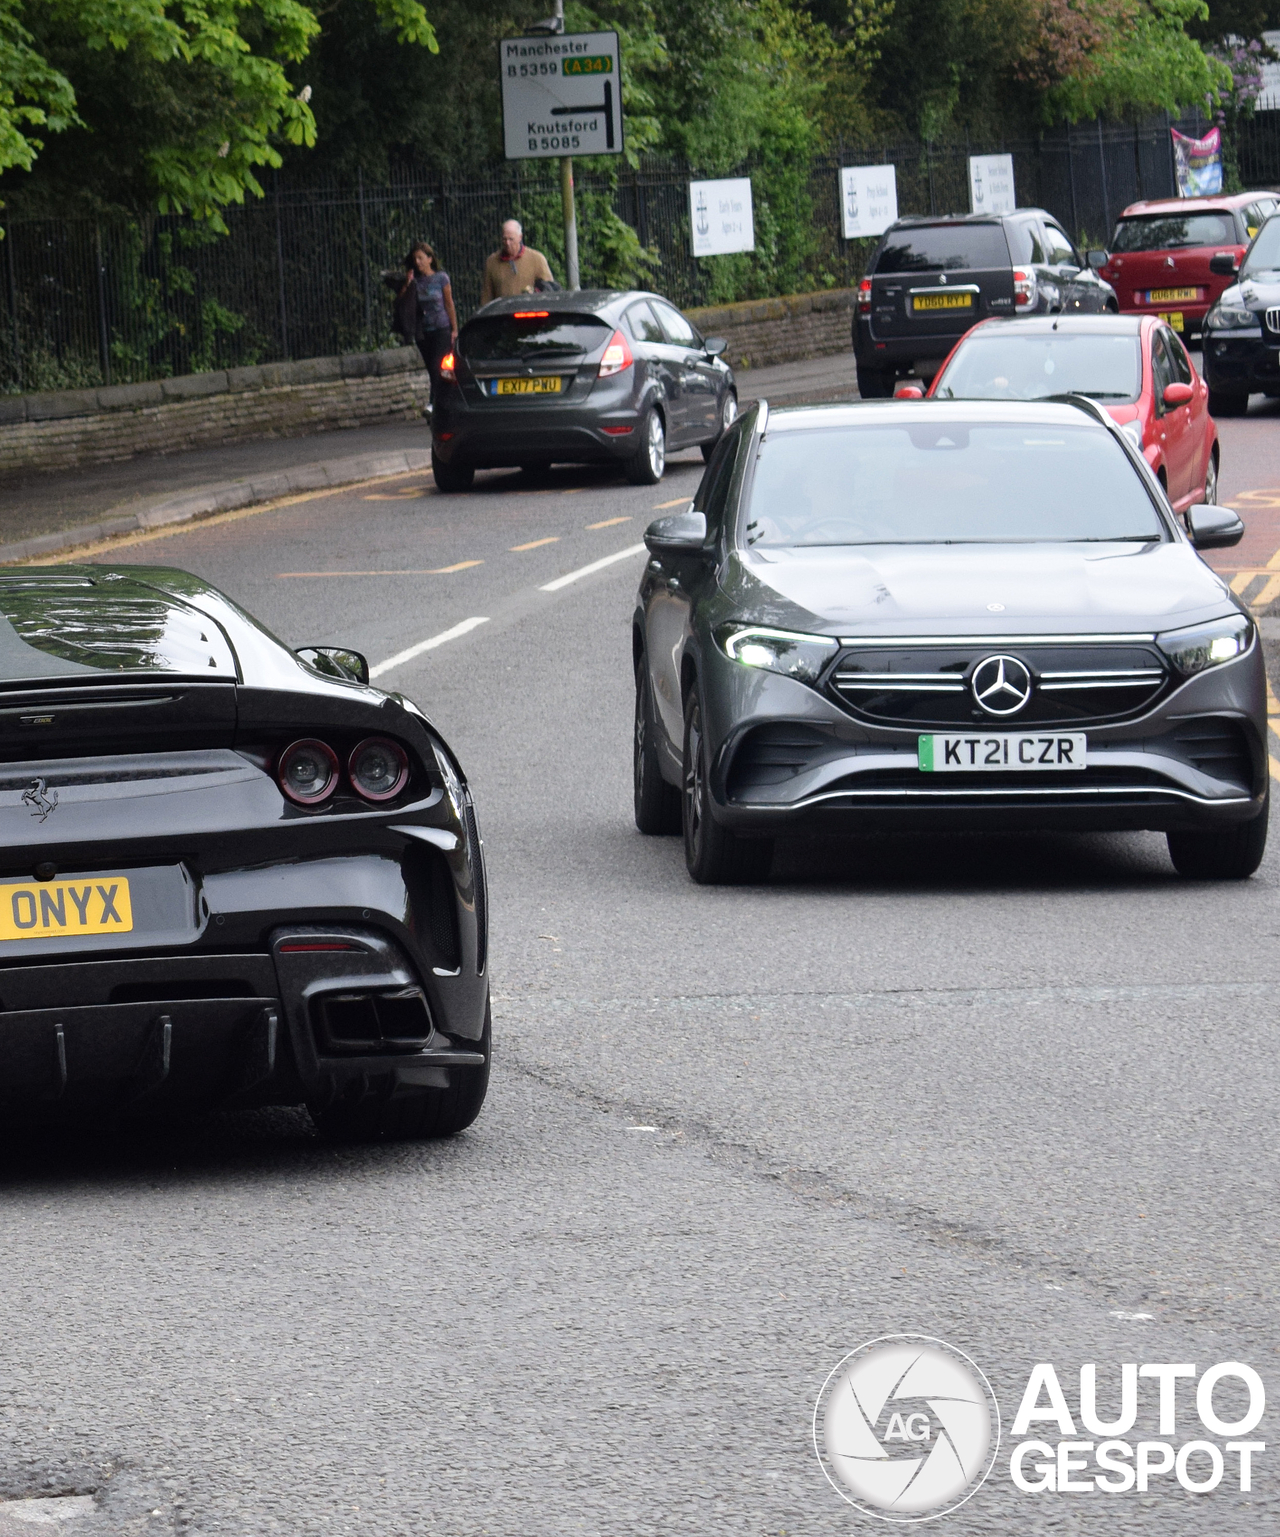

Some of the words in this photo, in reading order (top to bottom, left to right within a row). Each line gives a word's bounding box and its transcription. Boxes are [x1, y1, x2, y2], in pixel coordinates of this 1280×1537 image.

[506, 41, 588, 57] Manchester
[527, 119, 598, 135] Knutsford
[502, 379, 530, 393] EX17
[532, 378, 557, 392] PWU
[944, 739, 1009, 765] KT21
[1018, 738, 1074, 764] CZR
[11, 884, 123, 929] ONYX
